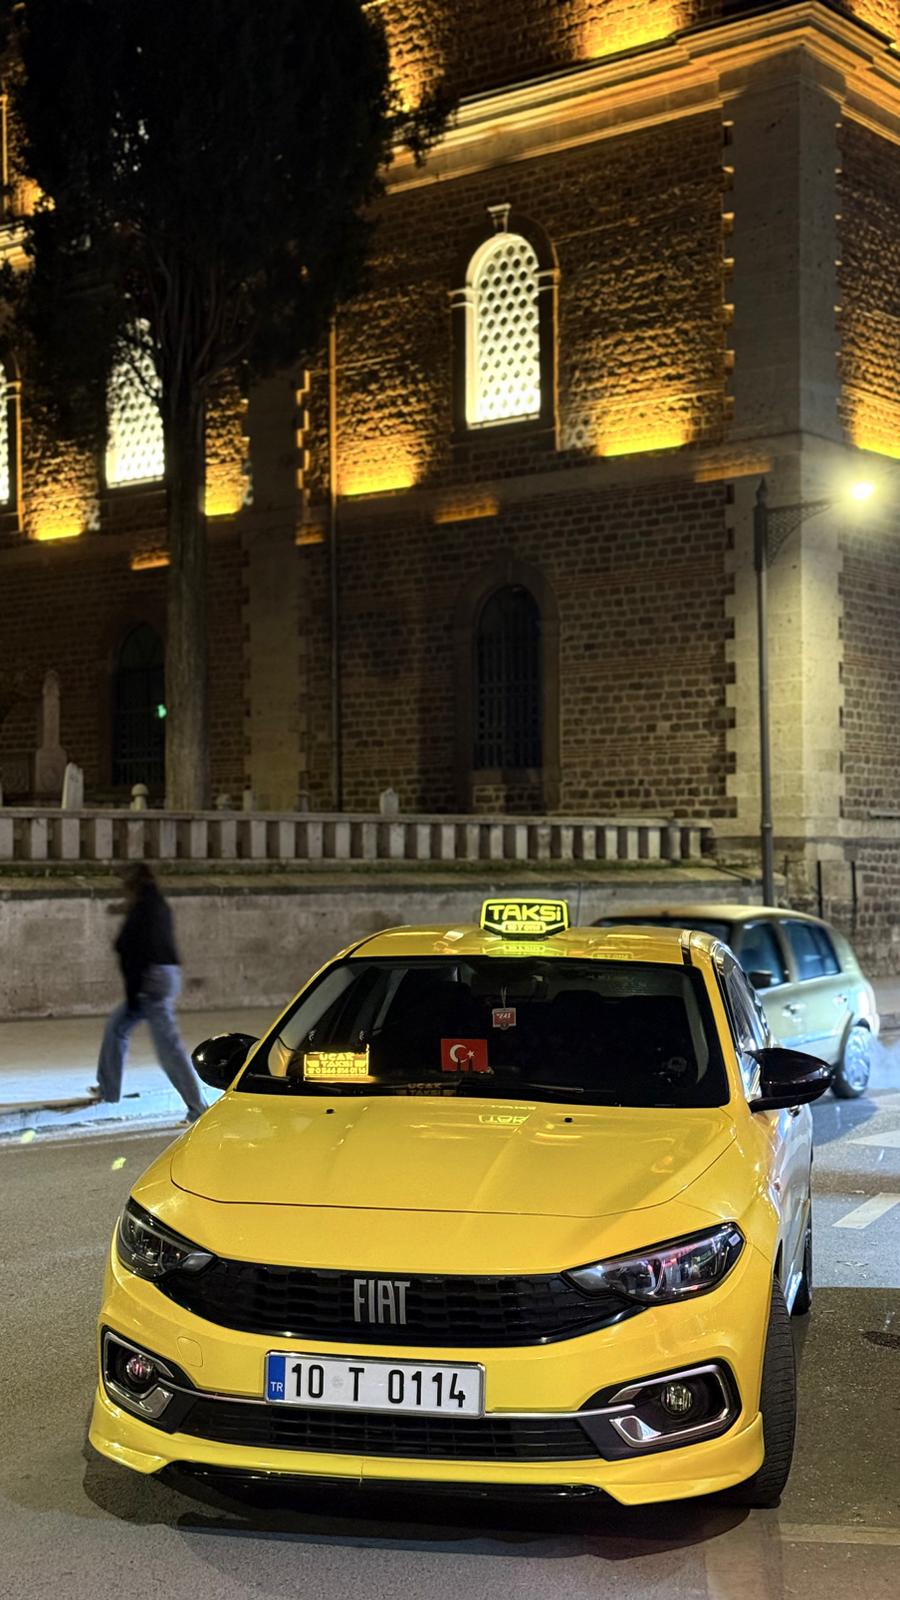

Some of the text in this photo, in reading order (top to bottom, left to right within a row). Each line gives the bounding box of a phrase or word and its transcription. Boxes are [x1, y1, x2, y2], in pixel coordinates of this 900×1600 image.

[354, 1279, 410, 1324] FIAT
[270, 1381, 284, 1393] TR
[292, 1363, 466, 1408] 10 T 0114
